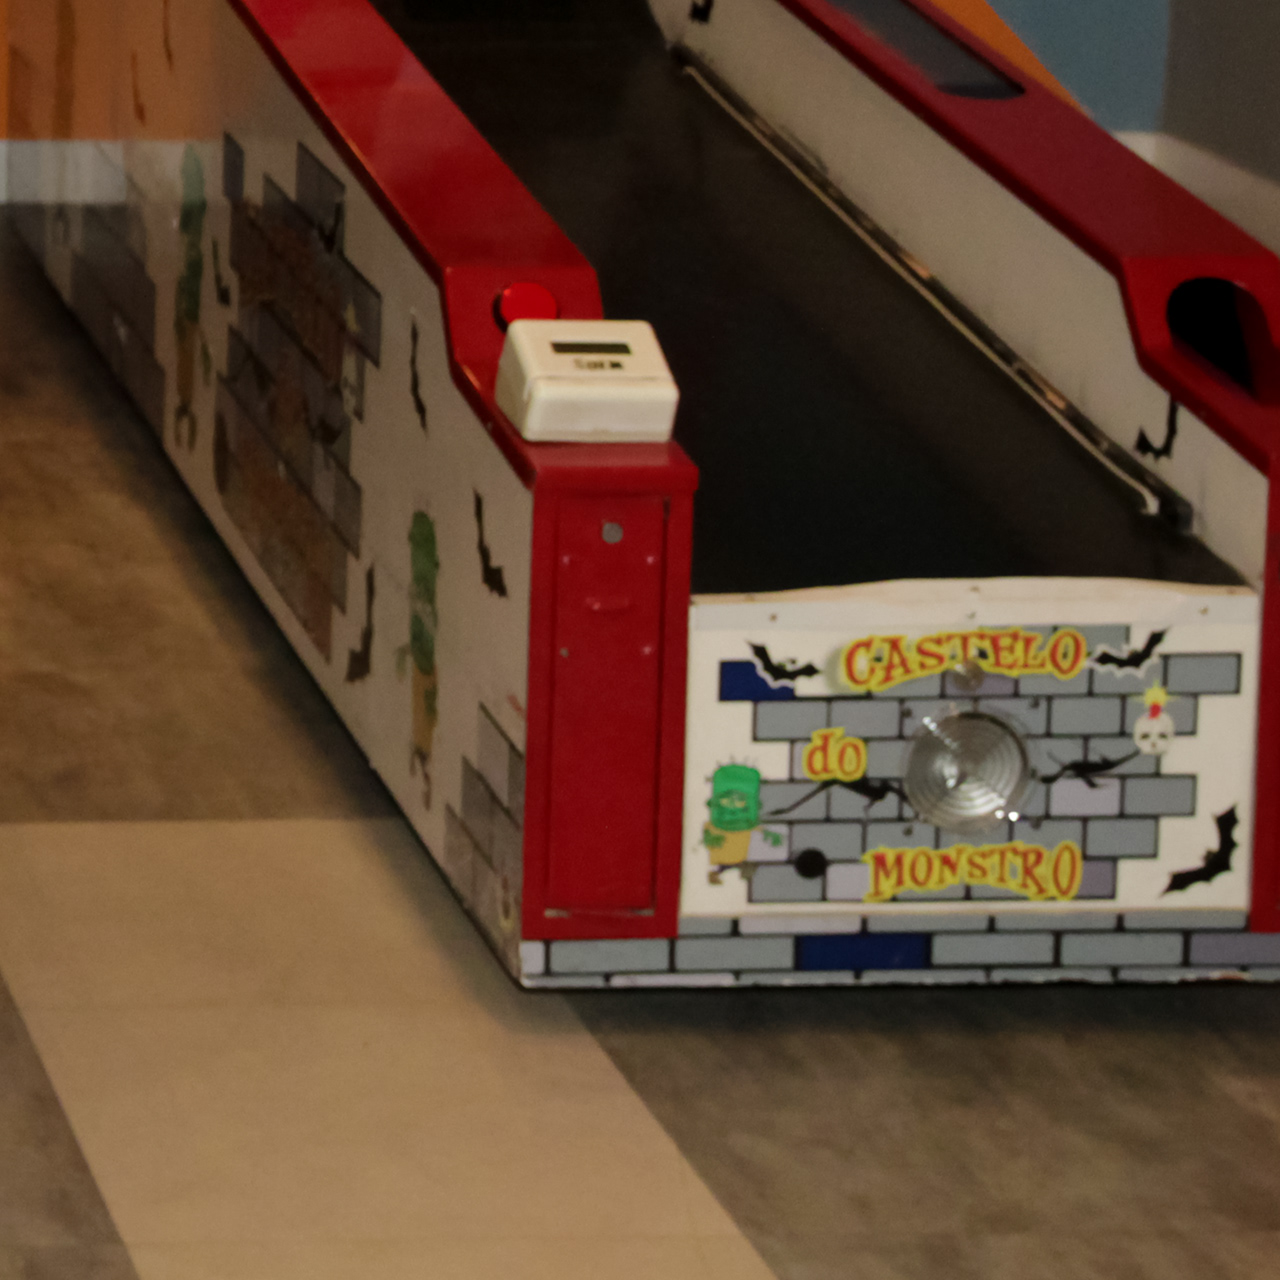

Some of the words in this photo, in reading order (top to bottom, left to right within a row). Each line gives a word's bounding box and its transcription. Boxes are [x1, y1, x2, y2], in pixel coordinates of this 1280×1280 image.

[844, 627, 1086, 691] CASTELO
[803, 728, 866, 782] do
[864, 841, 1083, 903] MONSTRO
